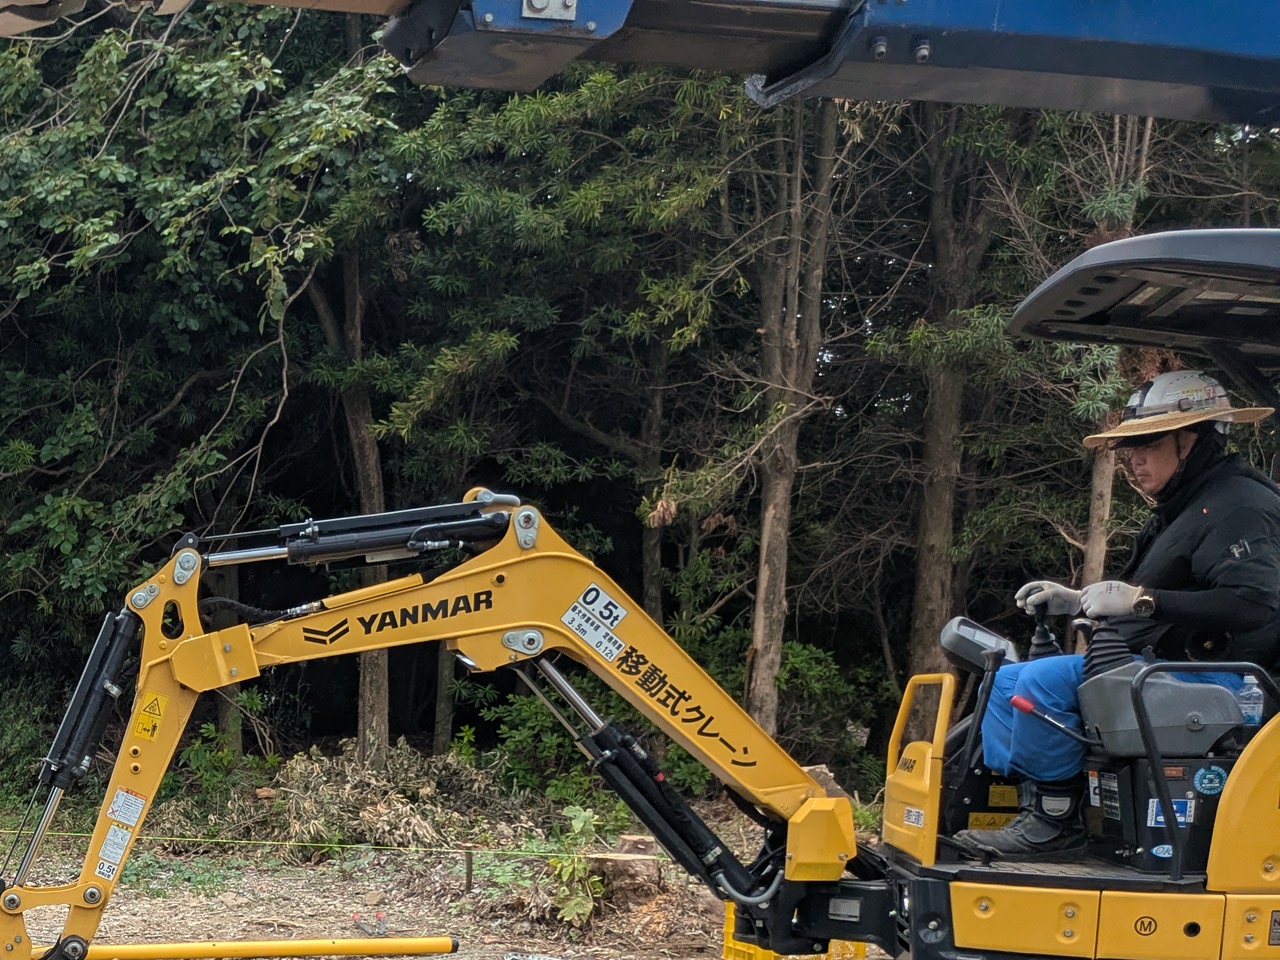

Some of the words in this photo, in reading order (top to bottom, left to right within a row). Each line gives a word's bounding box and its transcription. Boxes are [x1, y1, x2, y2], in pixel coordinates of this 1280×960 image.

[356, 590, 493, 635] YANMAR
[567, 617, 588, 637] 3.5m
[581, 587, 620, 627] 0.5t
[616, 645, 757, 767] 移動式クレーン
[98, 861, 116, 876] 0.5t
